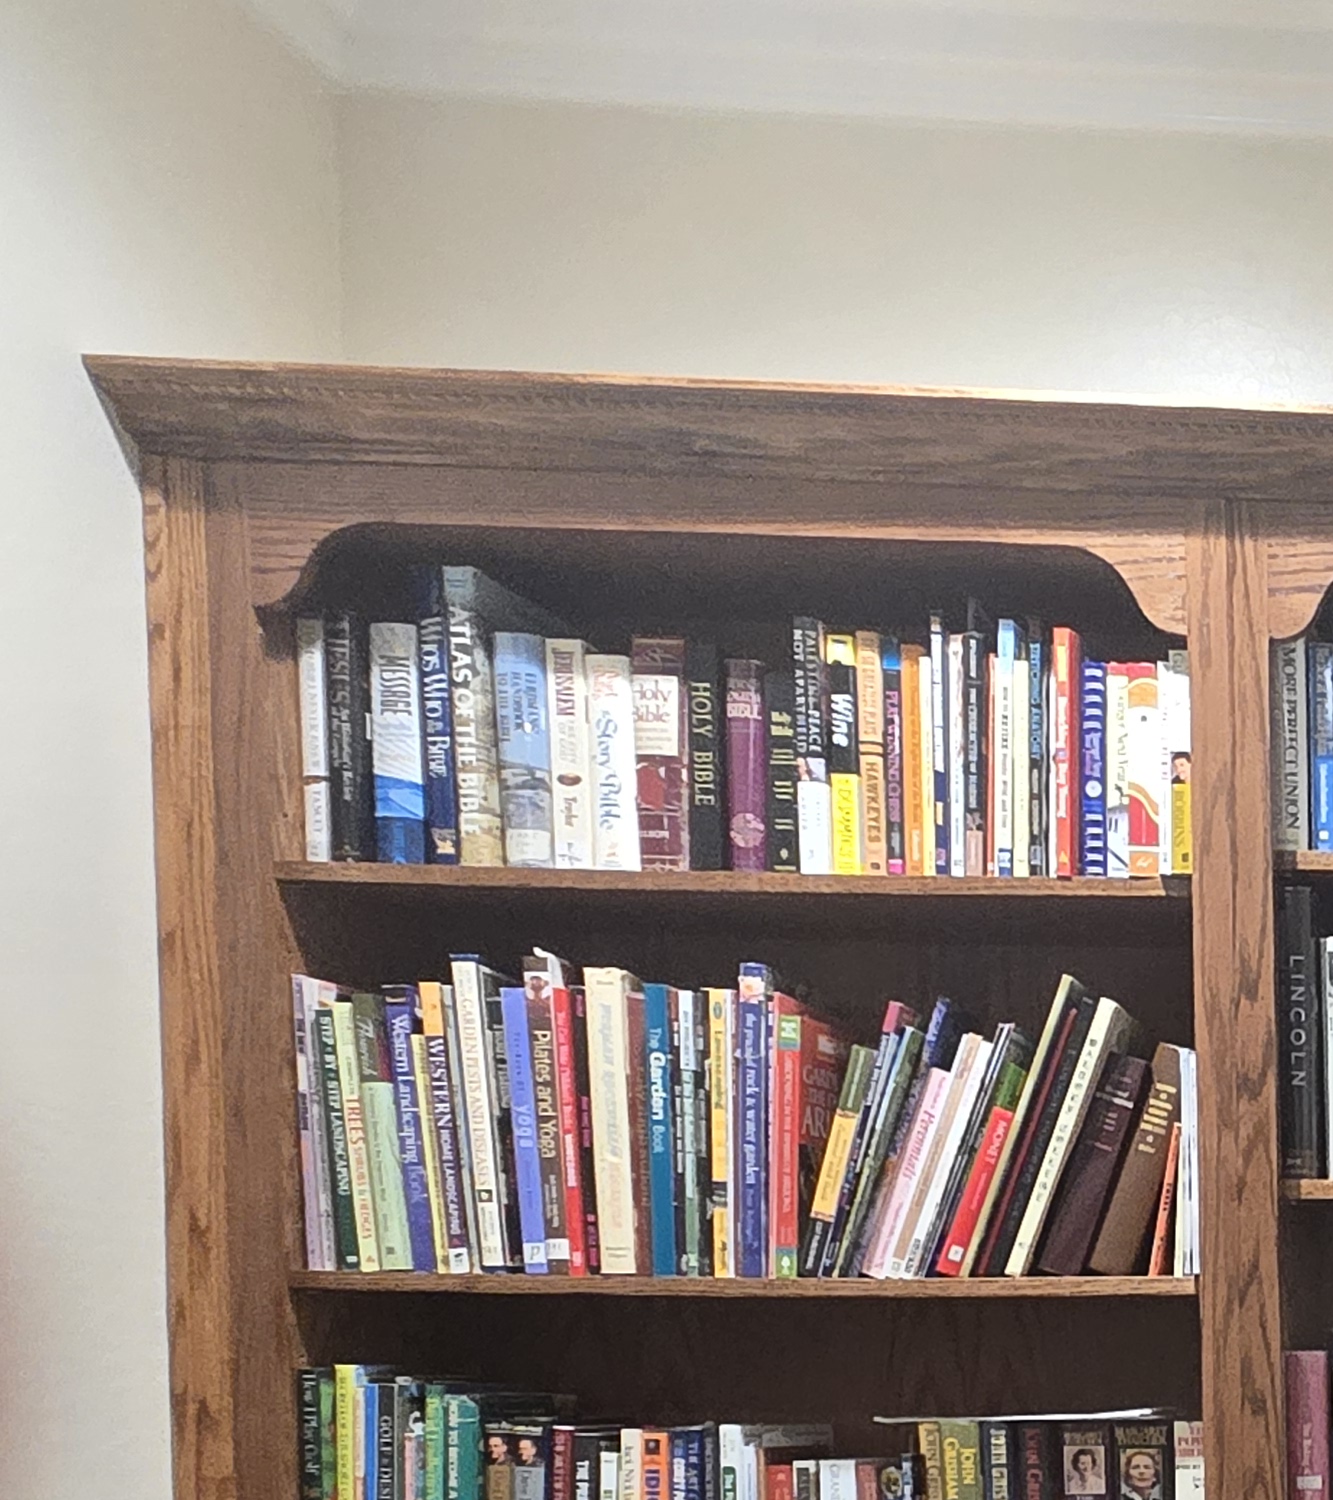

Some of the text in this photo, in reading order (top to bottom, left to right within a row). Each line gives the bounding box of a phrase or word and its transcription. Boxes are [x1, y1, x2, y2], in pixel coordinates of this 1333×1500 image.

[450, 606, 480, 838] ATLAS OF THE BIBLE
[691, 683, 714, 806] HOLY BIBLE
[831, 694, 853, 747] Wine
[1285, 773, 1300, 830] UNION
[391, 1014, 410, 1072] Western
[649, 1029, 663, 1048] The
[1289, 955, 1306, 1087] LINCOLN
[345, 1096, 361, 1145] TREES
[395, 1076, 420, 1164] Landscaping
[429, 1039, 452, 1127] WESTERN
[533, 1030, 557, 1158] Pilates and Yoga
[650, 1052, 668, 1120] Garden
